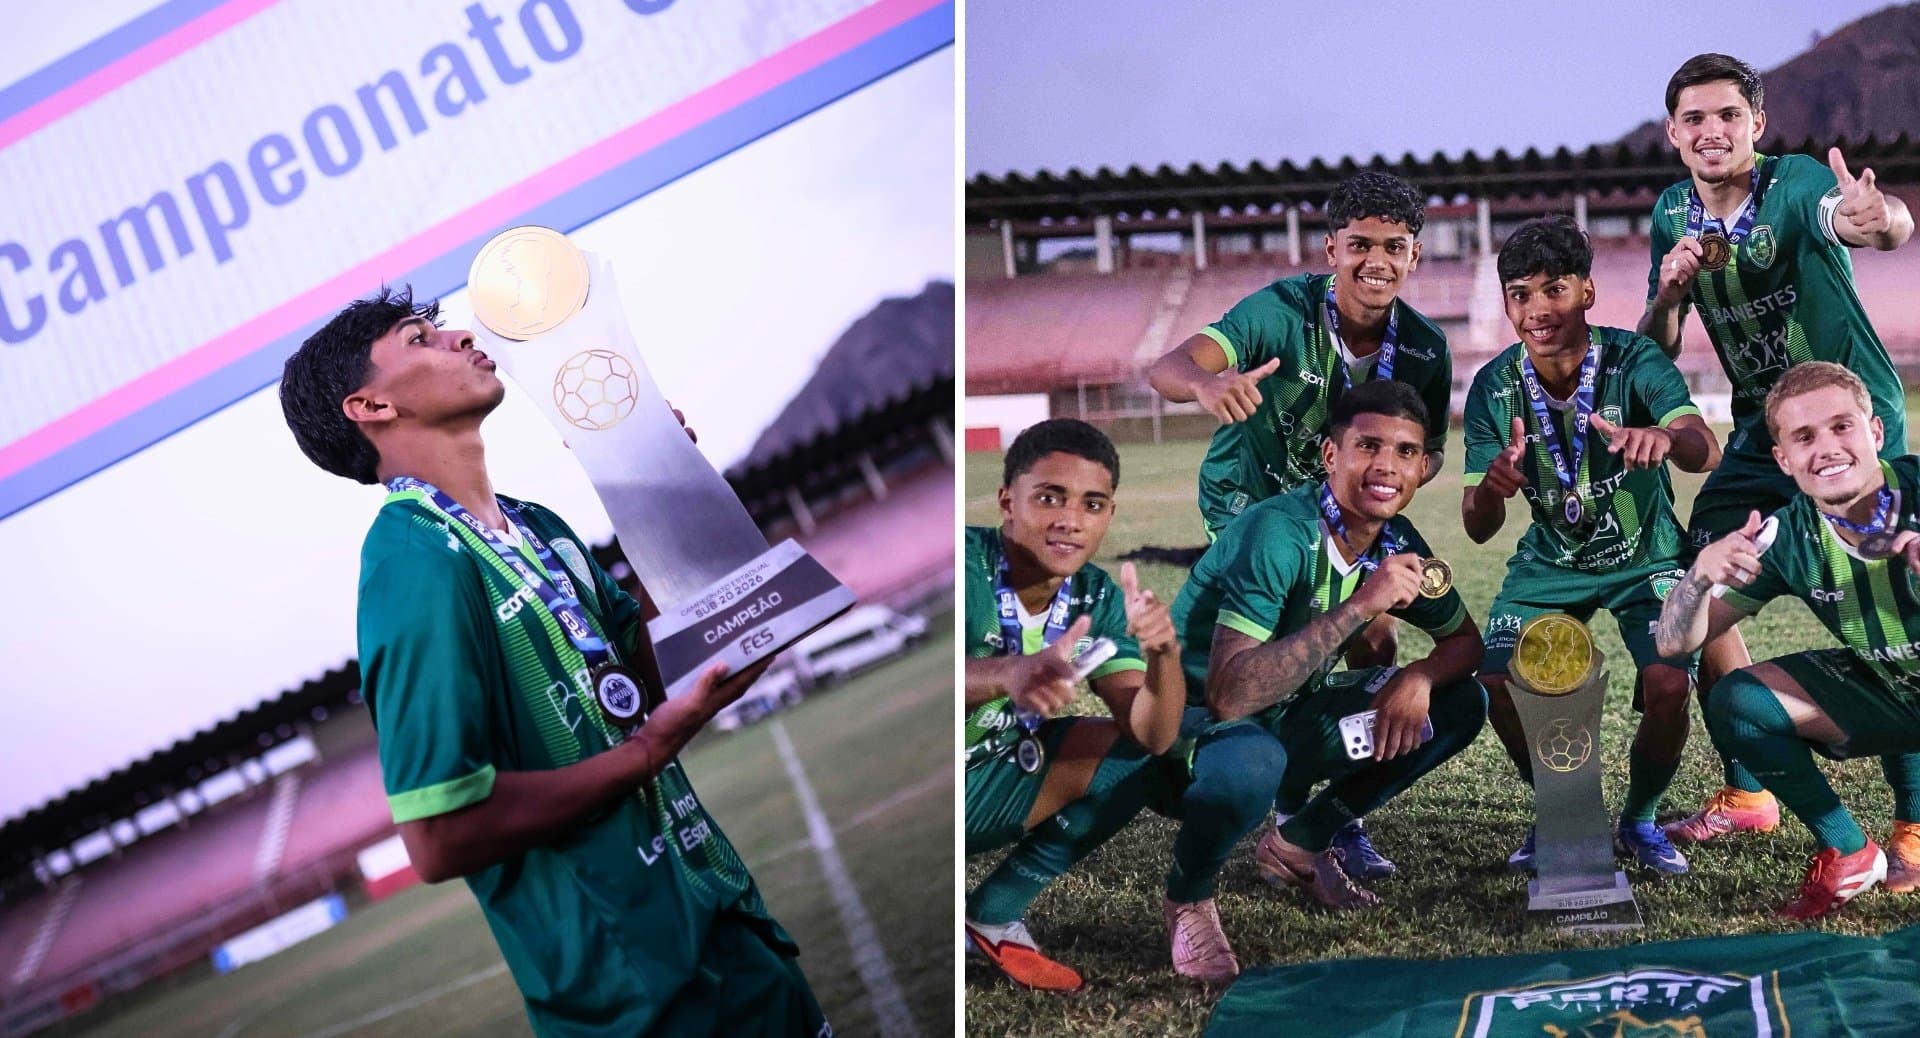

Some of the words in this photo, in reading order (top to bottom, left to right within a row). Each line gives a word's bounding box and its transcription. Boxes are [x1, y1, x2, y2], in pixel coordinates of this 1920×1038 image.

[1711, 284, 1798, 326] BANESTES
[734, 574, 763, 596] 2026
[703, 591, 783, 645] CAMPEÃO
[740, 627, 775, 656] FES
[1556, 911, 1609, 924] CAMPEÃO
